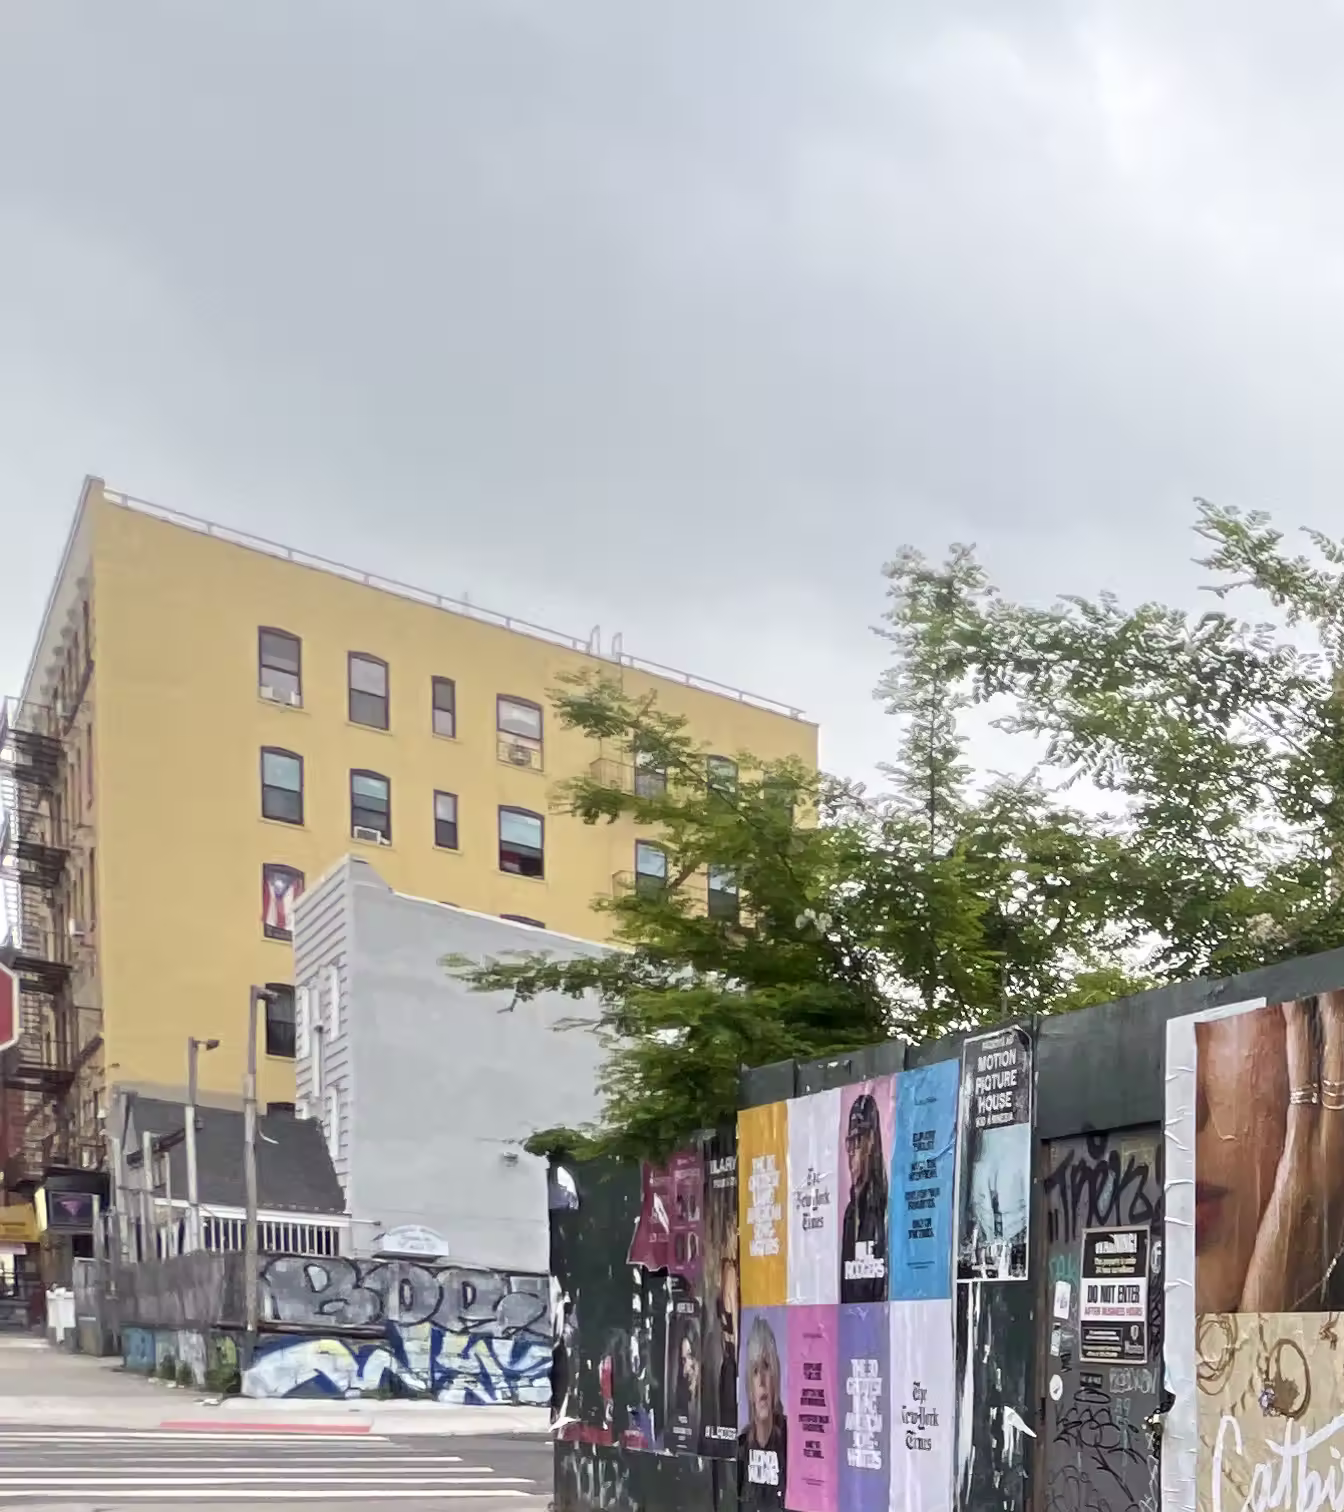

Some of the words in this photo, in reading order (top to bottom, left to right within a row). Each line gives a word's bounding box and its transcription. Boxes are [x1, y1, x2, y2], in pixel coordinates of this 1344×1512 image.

[978, 1048, 1016, 1072] MOTION
[977, 1091, 1013, 1114] HOUSE
[1087, 1285, 1099, 1304] DO
[1100, 1285, 1116, 1304] NOT
[1117, 1284, 1141, 1304] ENTER
